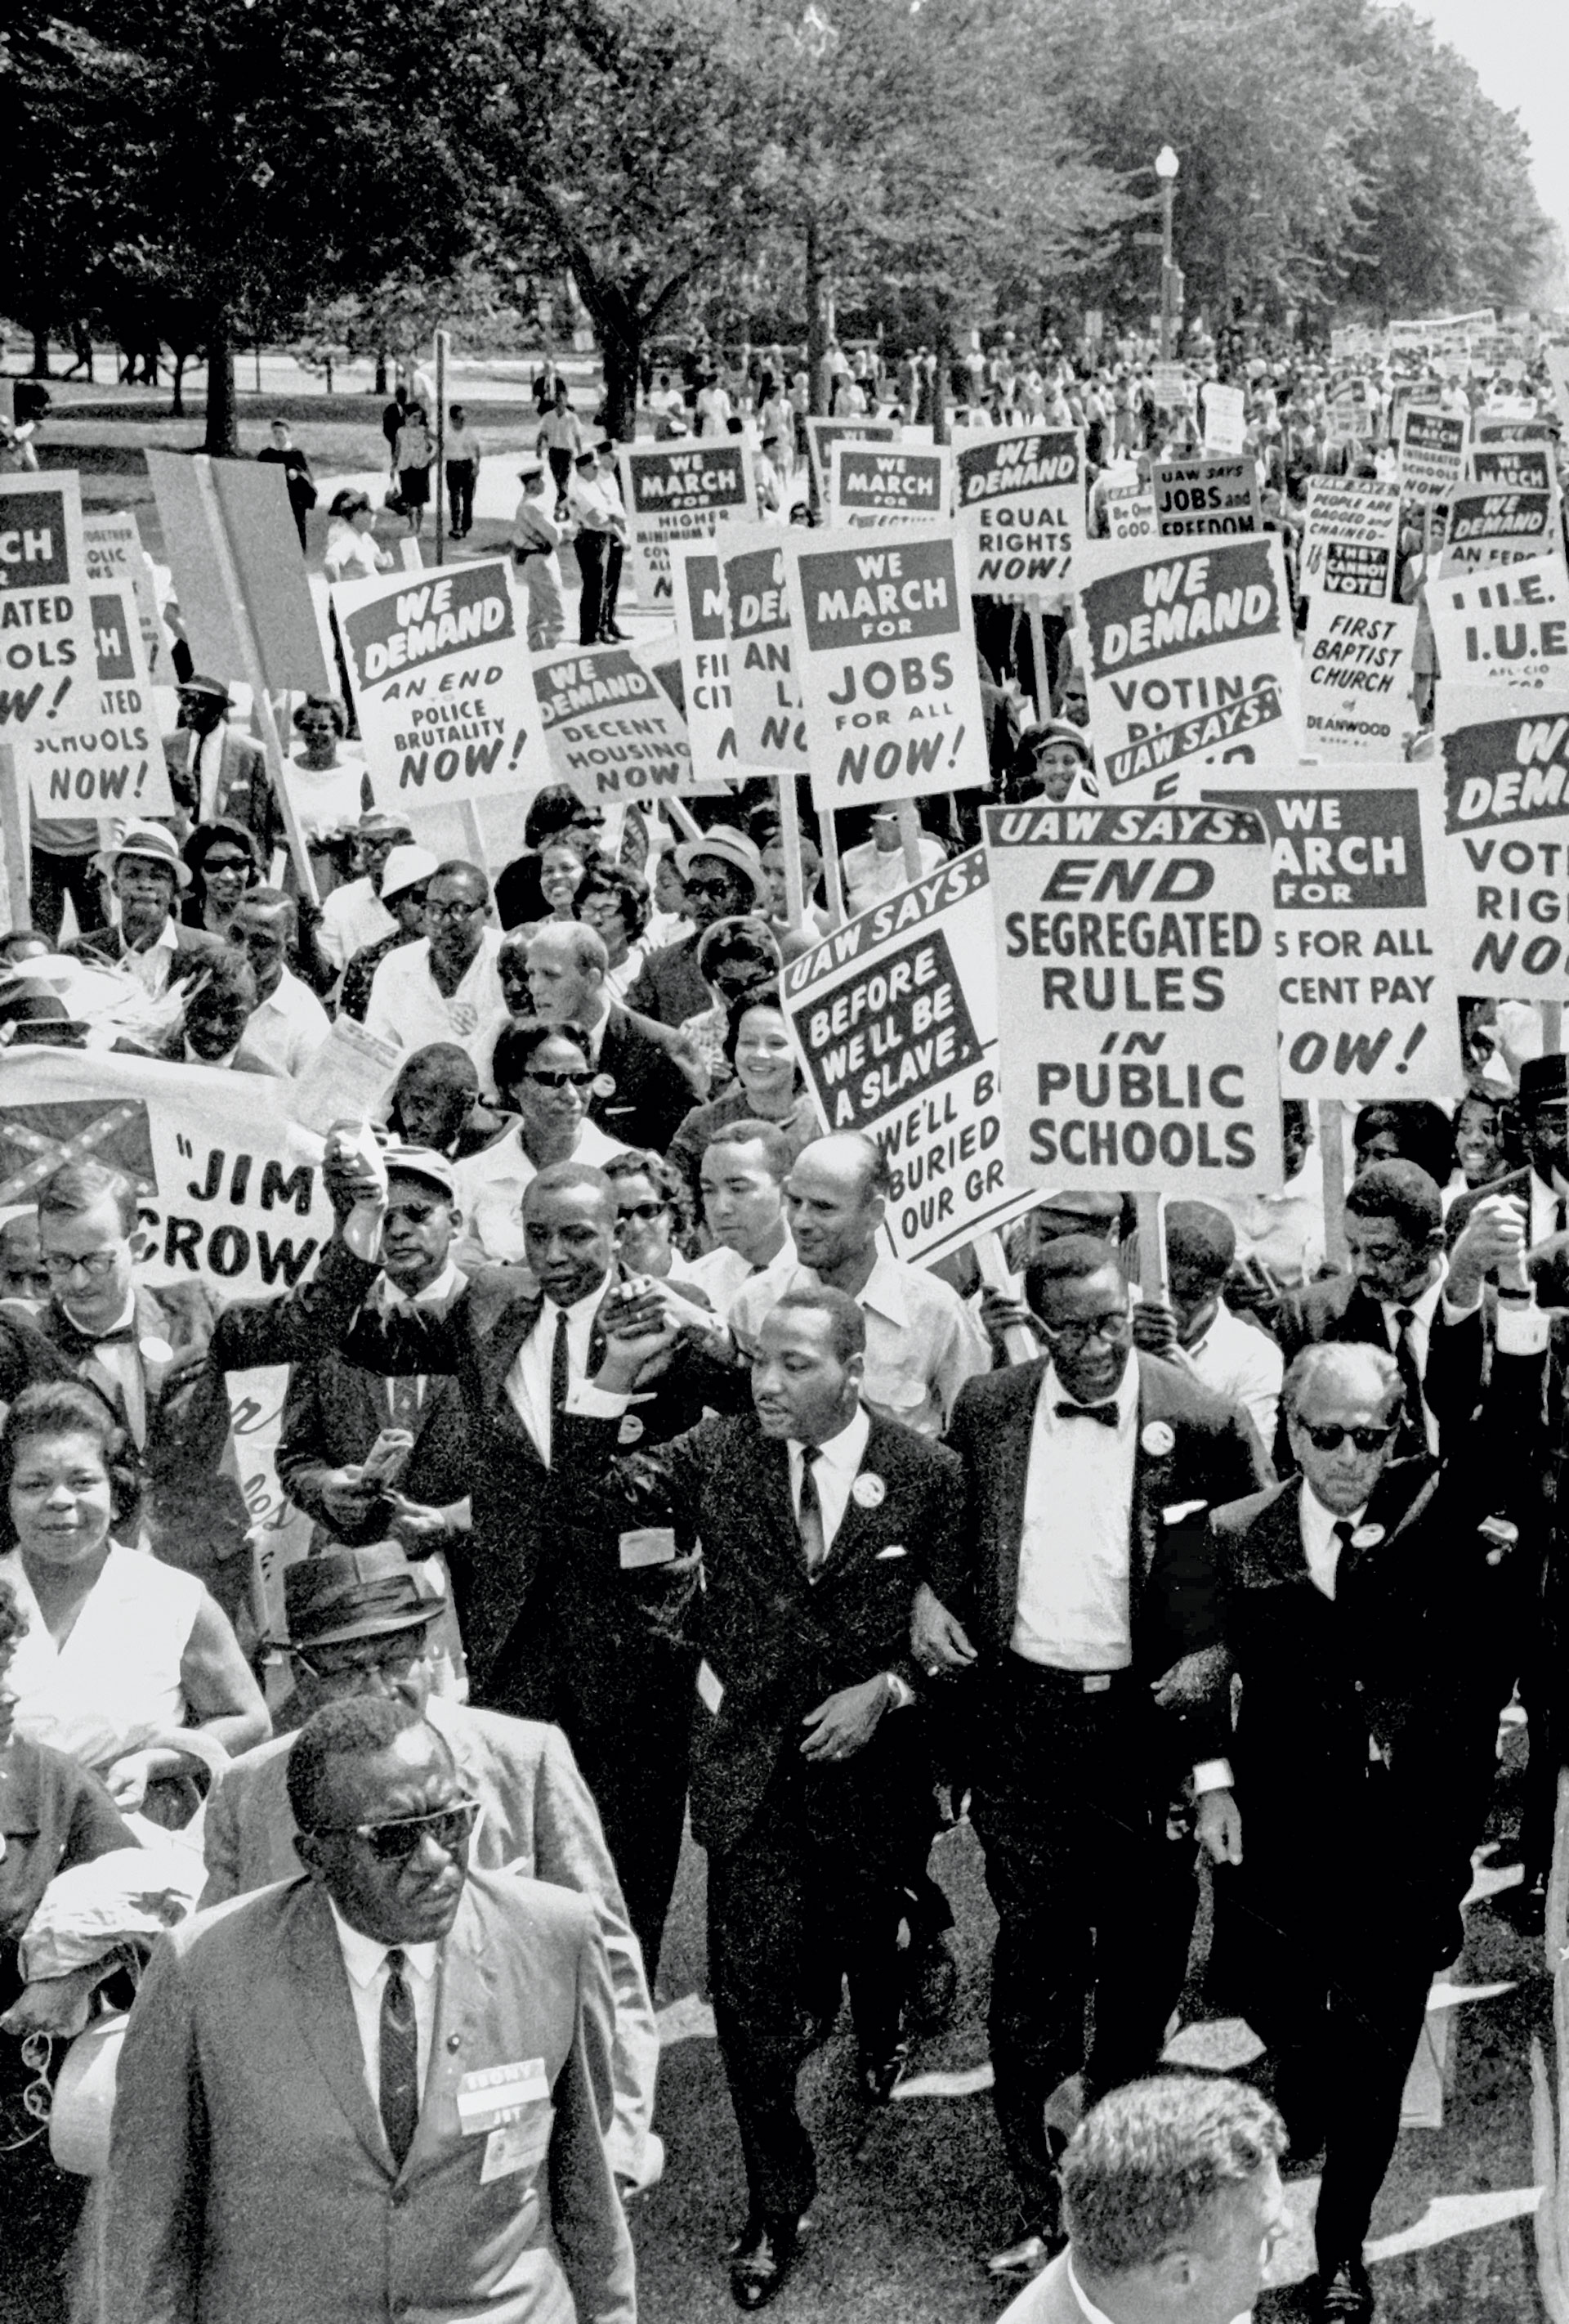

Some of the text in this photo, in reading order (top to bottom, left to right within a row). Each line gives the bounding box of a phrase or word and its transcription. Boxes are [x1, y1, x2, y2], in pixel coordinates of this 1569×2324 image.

[1409, 426, 1459, 441] MARCH
[669, 454, 704, 472] WE
[876, 457, 906, 473] WE
[997, 437, 1041, 467] WE
[1498, 456, 1521, 469] WE
[641, 469, 736, 497] MARCH
[846, 472, 933, 496] MARCH
[967, 455, 1075, 499] DEMAND
[1161, 464, 1244, 483] UAW SAYS
[1401, 463, 1459, 481] SCHOOLS
[672, 495, 710, 508] FOR
[874, 495, 908, 506] FOR
[1160, 486, 1222, 513] JOBS
[1403, 478, 1455, 497] NOW!
[981, 508, 1069, 527] EQUAL
[1484, 496, 1520, 515] WE
[1454, 512, 1542, 540] DEMAND
[979, 533, 1072, 553] RIGHTS
[1335, 545, 1381, 561] THEY
[1451, 546, 1482, 562] AN
[856, 553, 902, 580] WE
[977, 556, 1073, 580] NOW!
[1328, 559, 1386, 577] CANNOT
[1144, 557, 1209, 607] WE
[1327, 574, 1384, 595] VOTE
[396, 580, 453, 627] WE
[818, 577, 948, 622] MARCH
[365, 597, 504, 679] DEMAND
[861, 618, 913, 638] FOR
[1102, 584, 1271, 665] DEMAND
[1329, 615, 1397, 641] FIRST
[744, 642, 790, 673] AN
[1312, 639, 1403, 667] BAPTIST
[382, 666, 503, 702] AN END
[549, 659, 597, 689] WE
[828, 652, 954, 705] JOBS
[1311, 665, 1395, 693] CHURCH
[411, 699, 486, 727] POLICE
[539, 673, 647, 723] DEMAND
[562, 719, 667, 742] DECENT
[835, 702, 953, 731] FOR ALL
[1307, 714, 1391, 737] DEANWOOD
[394, 718, 504, 751] BRUTALITY
[1114, 734, 1174, 780] UAW
[1182, 693, 1273, 750] SAYS:
[400, 728, 528, 789] NOW!
[837, 724, 965, 786] NOW!
[50, 760, 148, 800] NOW!
[999, 809, 1254, 842] UAW SAYS:
[1276, 799, 1342, 831] WE
[1272, 836, 1407, 876] ARCH
[1463, 838, 1569, 876] VOT
[1040, 858, 1215, 902] END
[1280, 883, 1353, 904] FOR
[1477, 885, 1569, 924] RIG
[791, 854, 983, 990] UAW SAYS:
[1005, 911, 1262, 957] SEGREGATED
[1299, 929, 1362, 958] FOR
[1373, 929, 1433, 956] ALL
[1472, 930, 1569, 976] NO
[811, 947, 937, 1047] BEFORE
[1042, 965, 1225, 1012] RULES
[1370, 975, 1436, 1005] PAY
[912, 983, 954, 1034] BE
[1099, 1031, 1166, 1055] IN
[1277, 1021, 1428, 1076] OW!
[837, 1026, 970, 1126] A SLAVE,
[1037, 1063, 1245, 1108] PUBLIC
[877, 1070, 1002, 1156] WE'LL B
[1029, 1117, 1256, 1168] SCHOOLS
[889, 1115, 1000, 1202] BURIED
[902, 1187, 954, 1239] OUR
